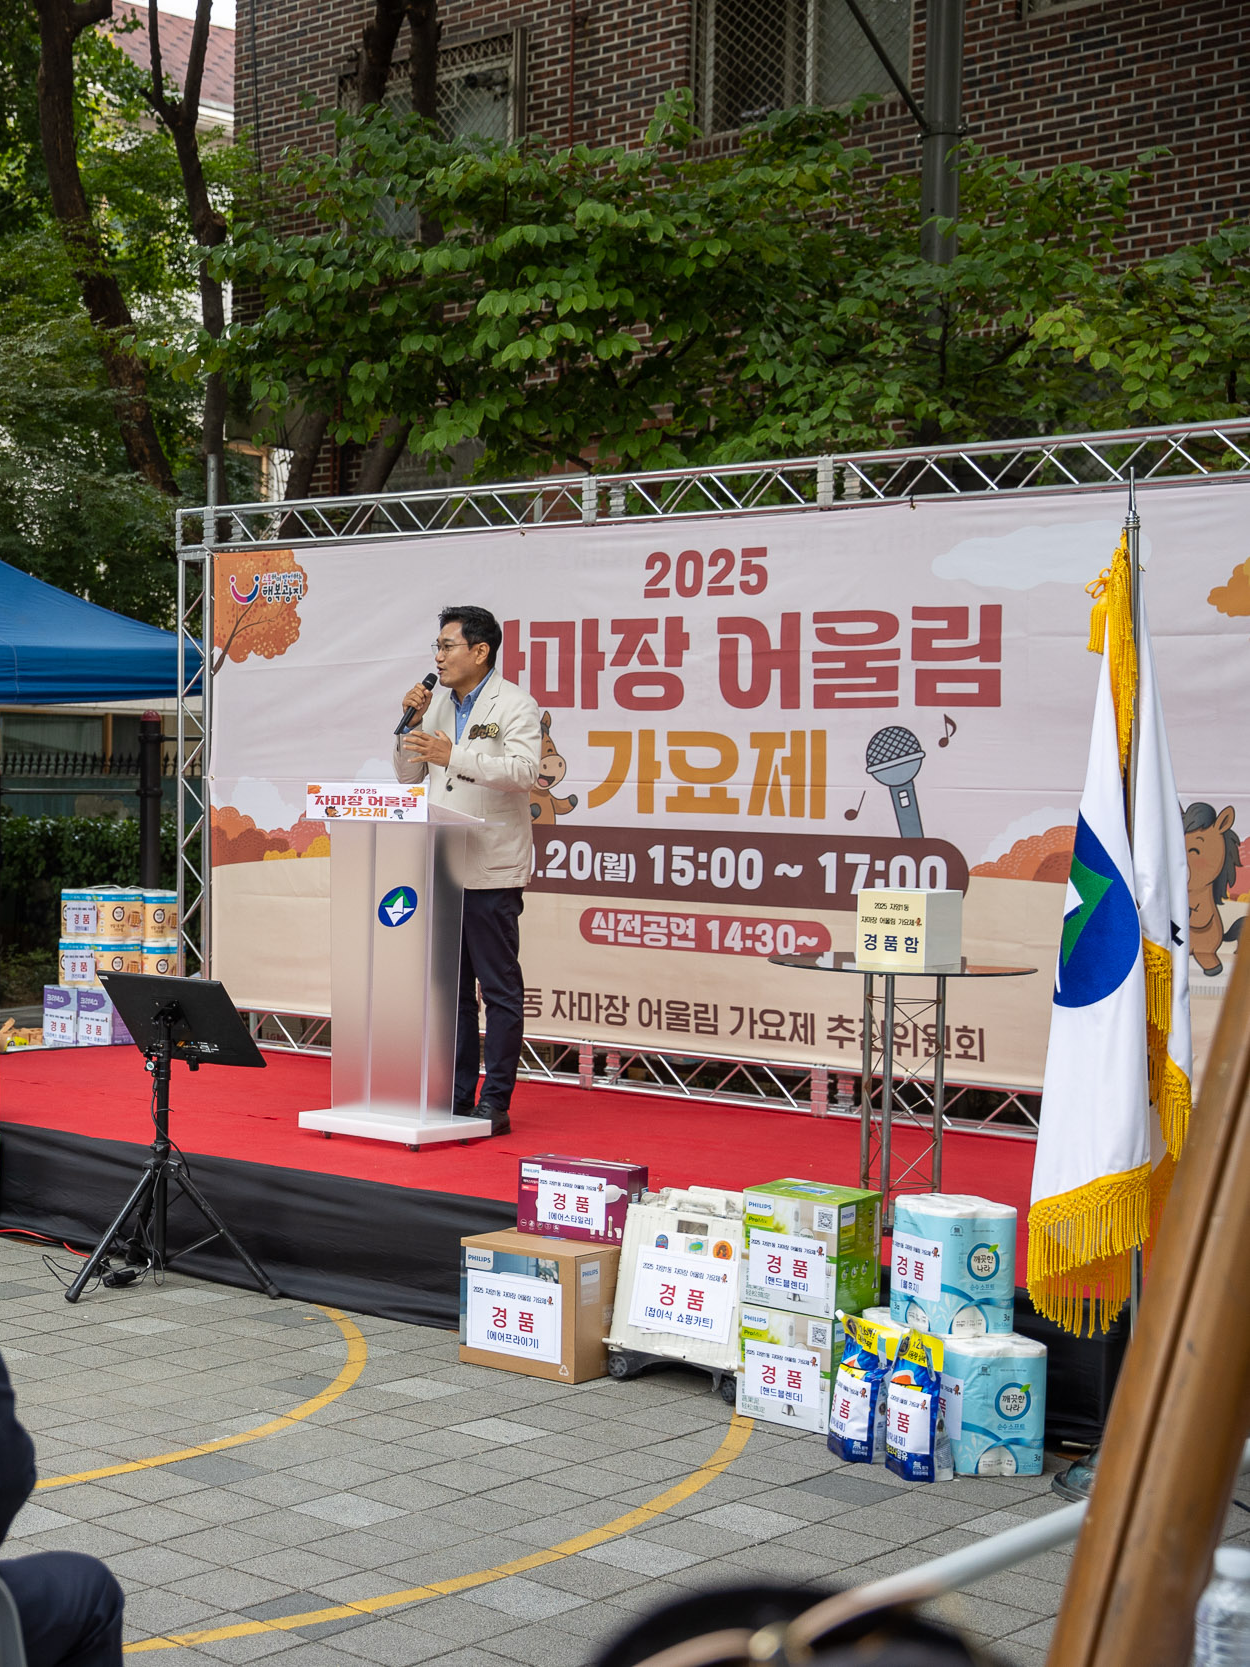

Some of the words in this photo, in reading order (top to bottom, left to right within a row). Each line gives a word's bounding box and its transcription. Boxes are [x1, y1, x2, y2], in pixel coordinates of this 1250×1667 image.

[644, 546, 768, 599] 2025
[262, 583, 303, 603] 행복광진
[717, 604, 1002, 709] 어울림
[588, 729, 827, 820] 가요제
[315, 795, 363, 806] 자마장
[368, 796, 417, 807] 어울림
[343, 807, 387, 817] 가요제
[532, 840, 637, 883] .20(월)
[647, 844, 764, 890] 15:00
[774, 862, 803, 878] ~
[817, 851, 948, 894] 17:00
[861, 916, 877, 924] 자마장
[879, 917, 896, 925] 어울림
[898, 918, 915, 926] 가요제
[591, 911, 696, 948] 식전공연
[706, 920, 819, 955] 14:30~
[551, 989, 630, 1026] 자마장
[637, 998, 719, 1035] 어울림
[730, 1006, 816, 1046] 가요제
[827, 1014, 985, 1063] 추진위원회
[748, 1201, 772, 1210] PHILIPS
[548, 1211, 594, 1226] [에어스타일러]
[841, 1212, 855, 1220] PHILIPS
[467, 1254, 491, 1263] PHILIPS
[973, 1254, 994, 1264] 깨끗한
[582, 1268, 599, 1278] PHILIPS
[674, 1267, 688, 1277] 자마장
[705, 1273, 721, 1283] 가요제
[976, 1264, 991, 1273] 나라
[765, 1275, 809, 1292] [핸드블렌더]
[644, 1306, 673, 1321] [접이식
[676, 1313, 713, 1329] 쇼핑카트]
[743, 1314, 767, 1324] PHILIPS
[486, 1329, 539, 1349] [에어프라이기]
[760, 1385, 803, 1403] [핸드블렌더]
[1002, 1394, 1025, 1404] 깨끗한
[1005, 1404, 1020, 1412] 나라
